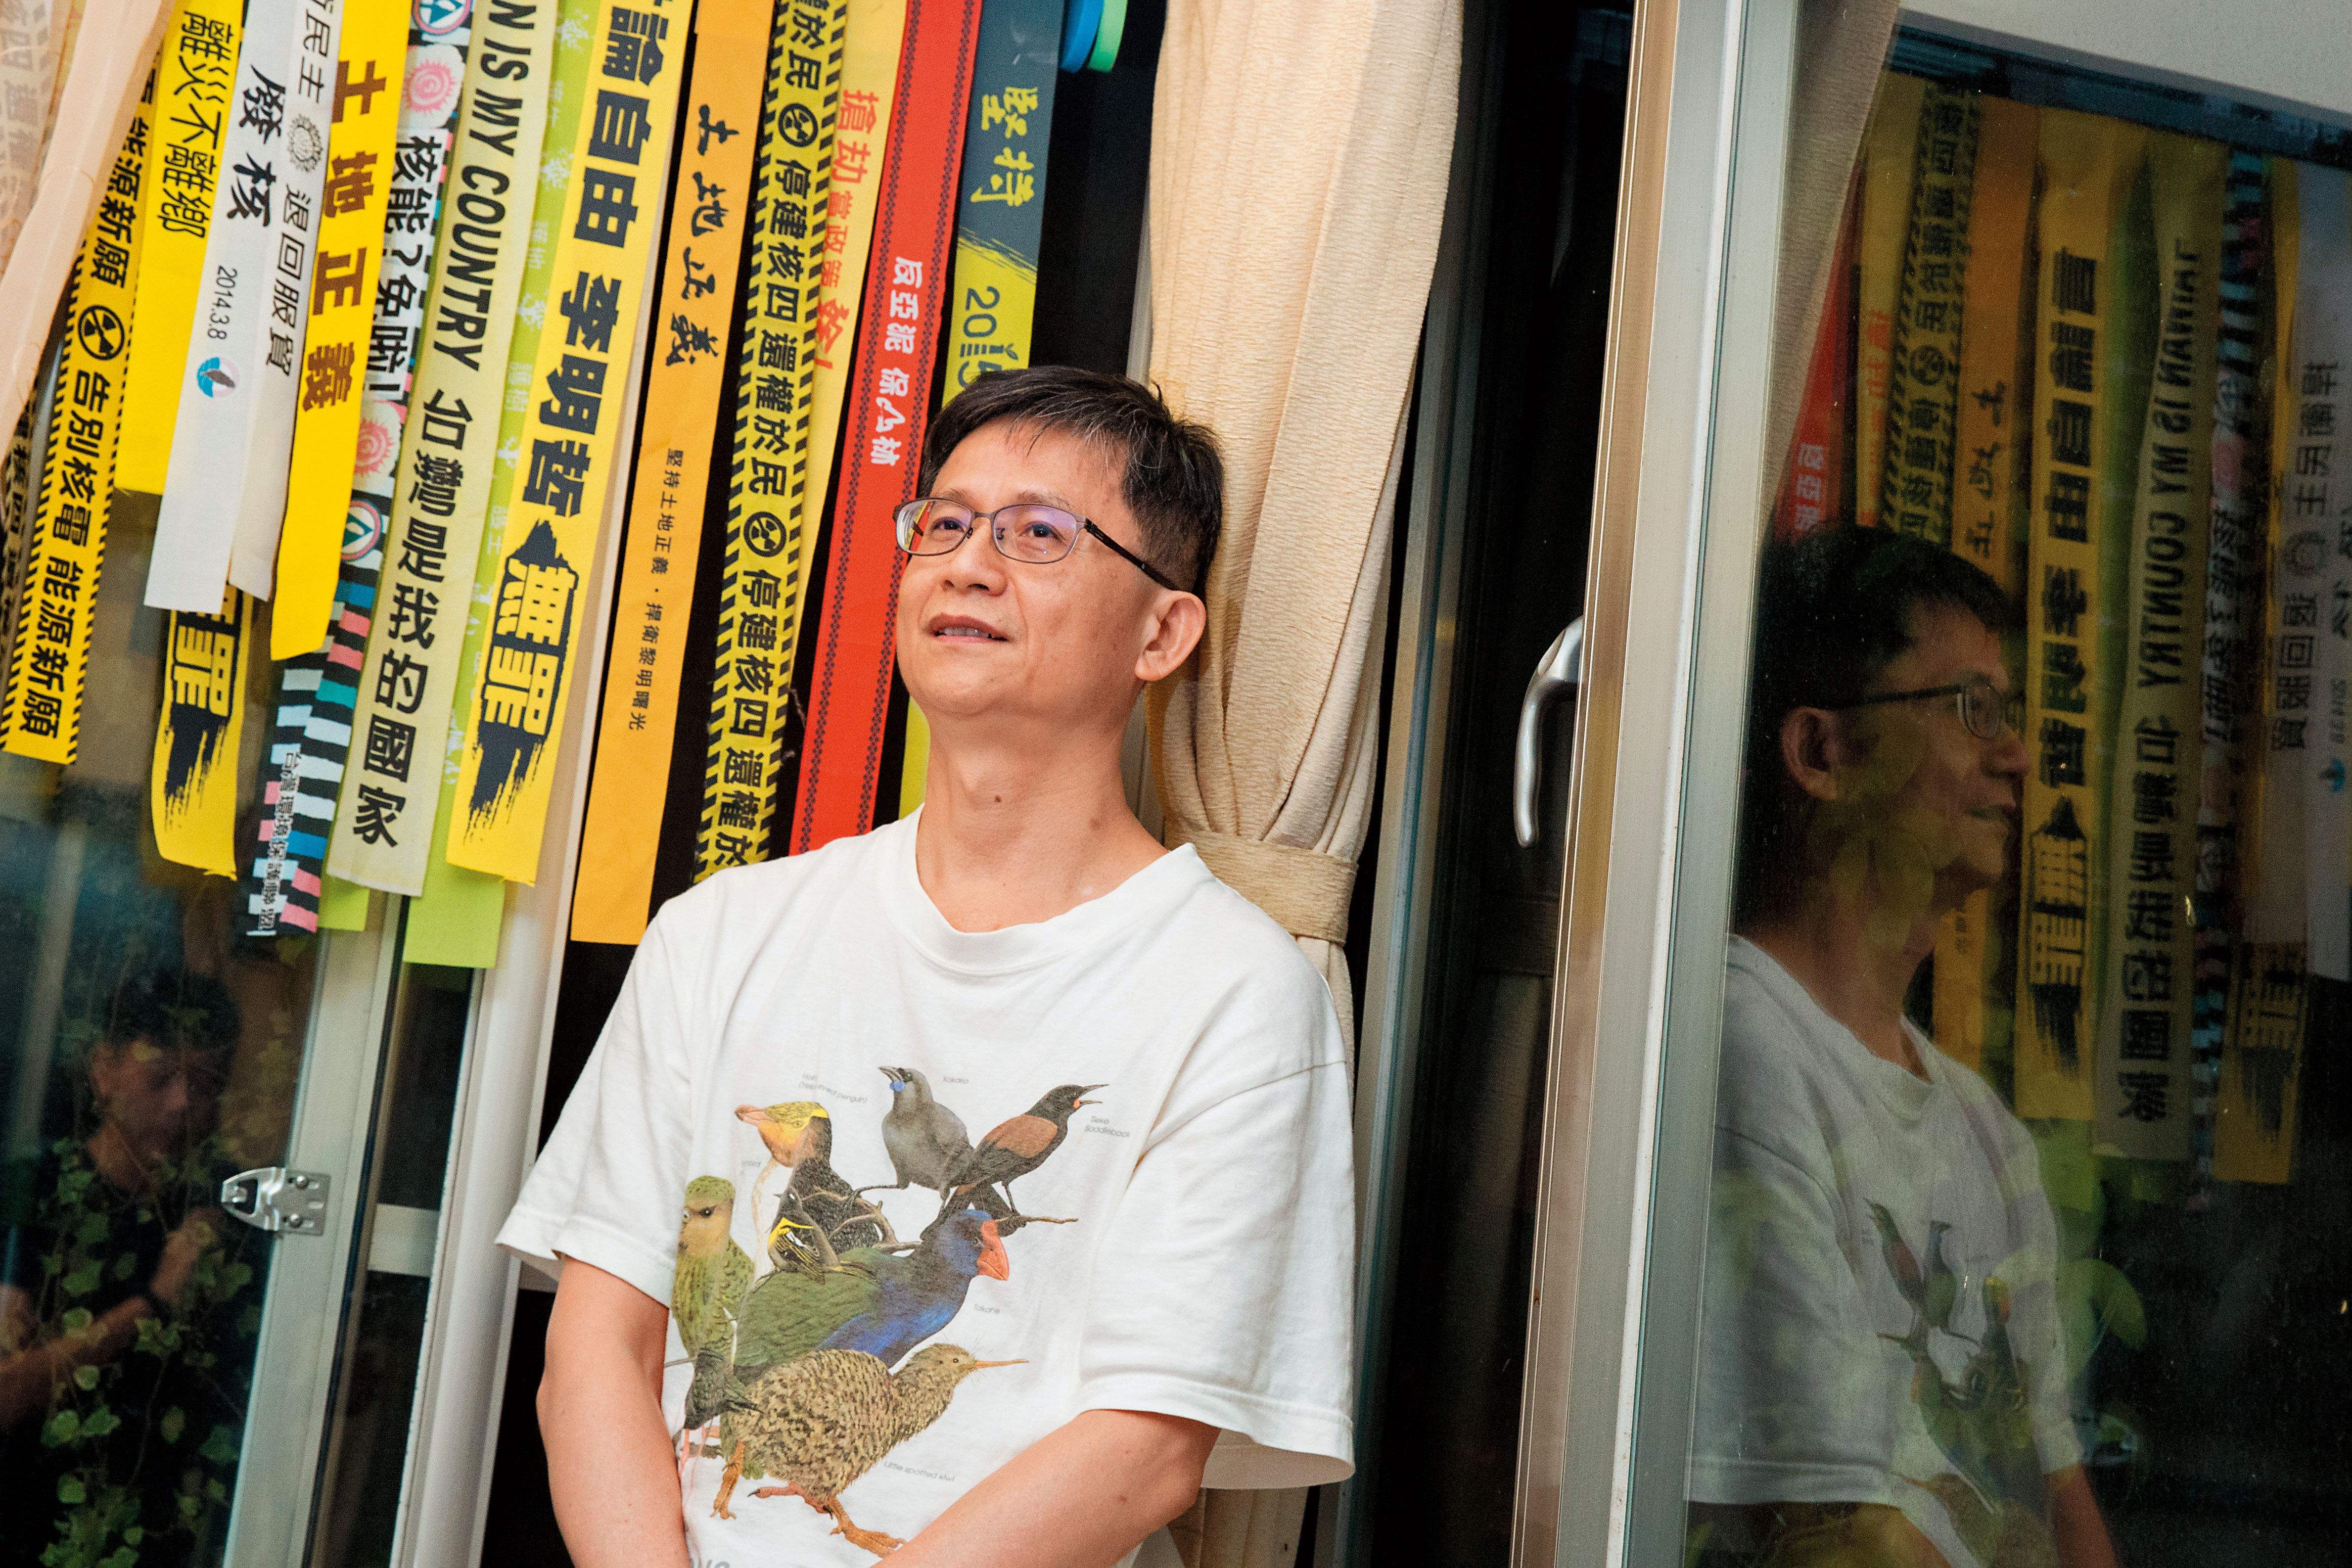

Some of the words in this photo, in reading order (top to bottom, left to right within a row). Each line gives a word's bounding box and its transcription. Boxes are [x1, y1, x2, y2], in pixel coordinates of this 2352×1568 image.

[157, 11, 234, 238] 離災不離鄉
[300, 0, 334, 103] 民主
[469, 89, 523, 157] MY
[480, 38, 531, 81] IS
[574, 0, 669, 248] 論自由
[785, 0, 823, 91] 於民
[971, 86, 1038, 206] 堅持
[207, 265, 238, 341] 2014.3.8
[266, 184, 311, 376] 退回服貿
[302, 60, 387, 412] 土地正義
[434, 165, 510, 372] COUNTRY
[666, 104, 740, 366] 土地正義
[765, 158, 811, 324] 停建核四
[886, 257, 923, 353] 反亞泥
[51, 370, 111, 547] 告別核電
[522, 271, 622, 519] 李明哲
[750, 329, 799, 497] 還權於民
[19, 555, 84, 740] 能源新願
[173, 589, 240, 717] 罪
[353, 388, 473, 848] 台灣是我的國家
[484, 560, 575, 736] 無罪
[732, 568, 781, 738] 停建核四
[904, 1466, 938, 1479] spotted
